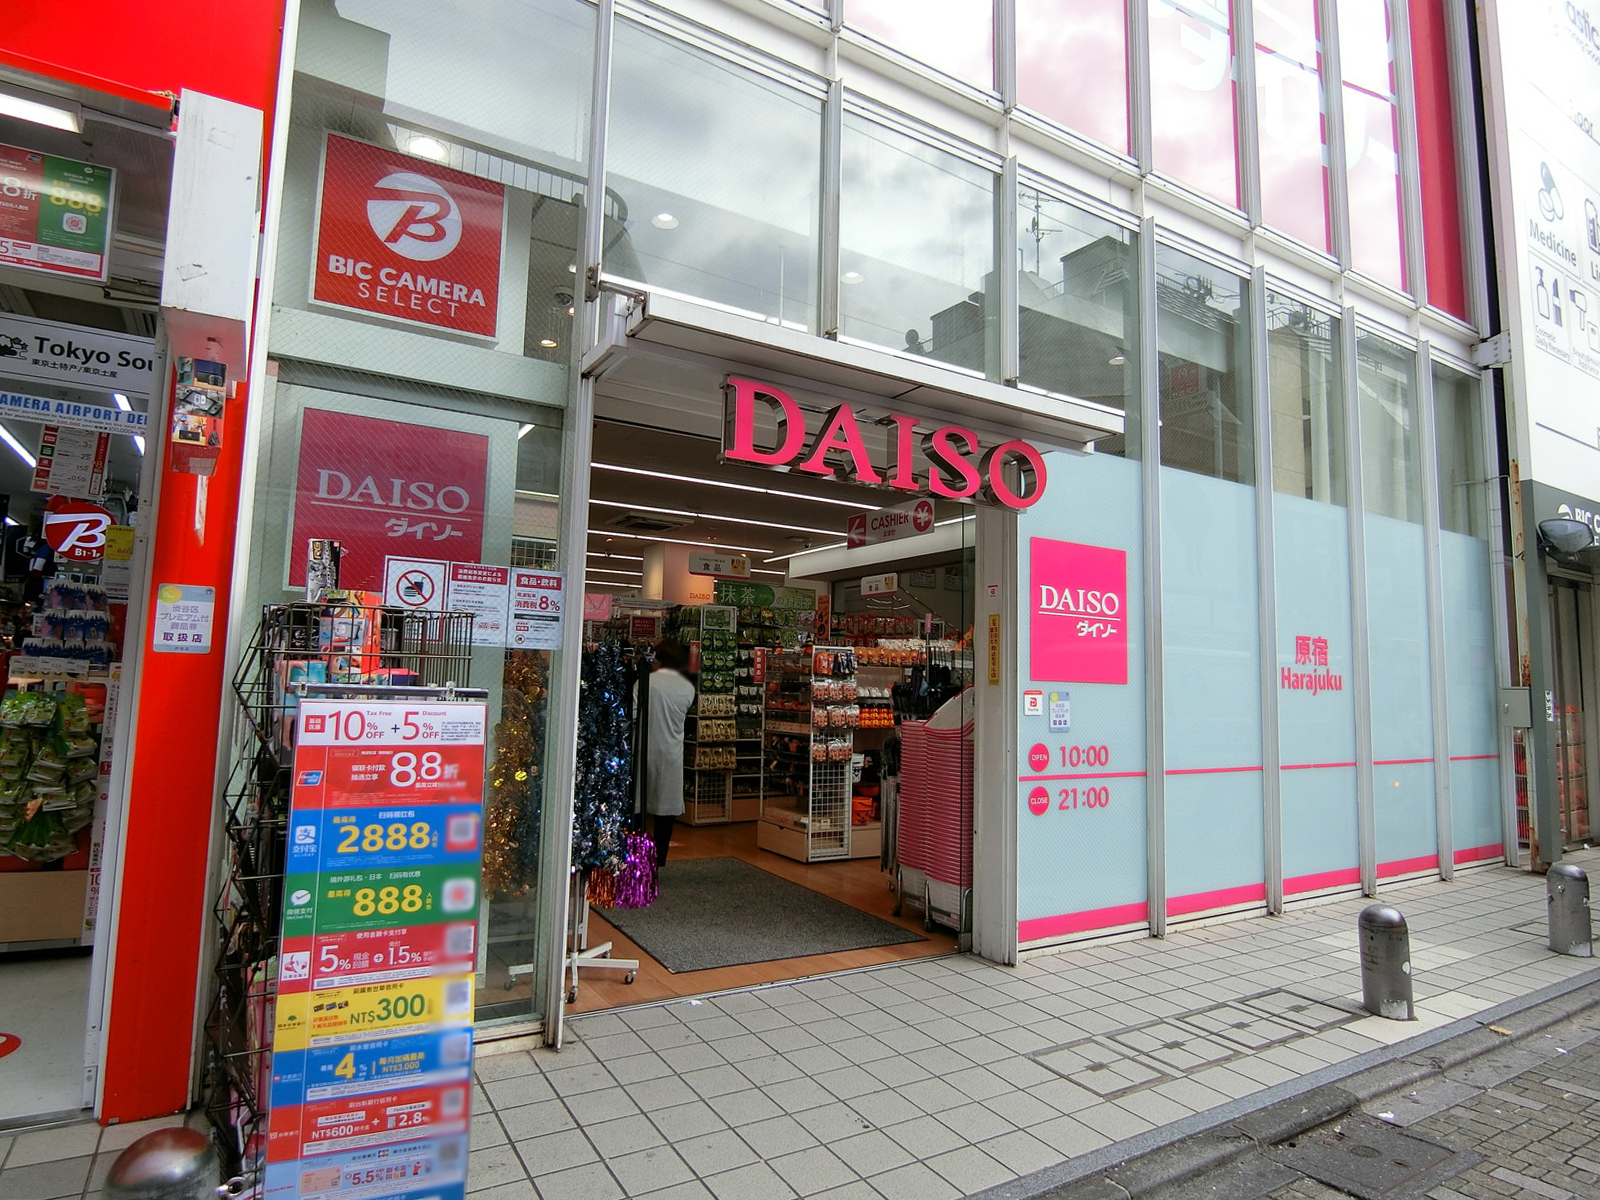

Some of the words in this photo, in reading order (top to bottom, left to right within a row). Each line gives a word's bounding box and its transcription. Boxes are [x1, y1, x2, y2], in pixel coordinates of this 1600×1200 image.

[1529, 218, 1577, 267] Medicine
[328, 254, 373, 280] BIC
[380, 267, 486, 306] CAMERA
[358, 282, 460, 317] SELECT
[34, 336, 110, 364] Tokyo
[56, 402, 121, 422] AIRPORT
[725, 376, 1046, 509] DAISO
[315, 469, 470, 514] DAISO
[385, 518, 462, 541] ダイソー
[871, 510, 909, 531] CASHIER
[703, 562, 721, 572] 食品
[521, 576, 557, 587] 食品・飲料
[720, 584, 755, 604] 抹茶
[1039, 585, 1119, 615] DAISO
[160, 613, 209, 622] プレミアム付
[1076, 621, 1116, 637] ダイソー
[163, 632, 203, 642] 取扱店
[1295, 635, 1328, 666] 原宿
[1281, 667, 1342, 696] Harajuku
[328, 710, 366, 741] 10
[403, 712, 420, 740] 5
[1060, 745, 1109, 767] 10:00
[1059, 786, 1109, 810] 21:00
[292, 845, 316, 853] 支付宝
[337, 822, 430, 853] 2888
[353, 884, 423, 917] 888
[350, 994, 425, 1024] NT$300
[334, 1053, 356, 1079] 4
[312, 1125, 353, 1139] NT$600
